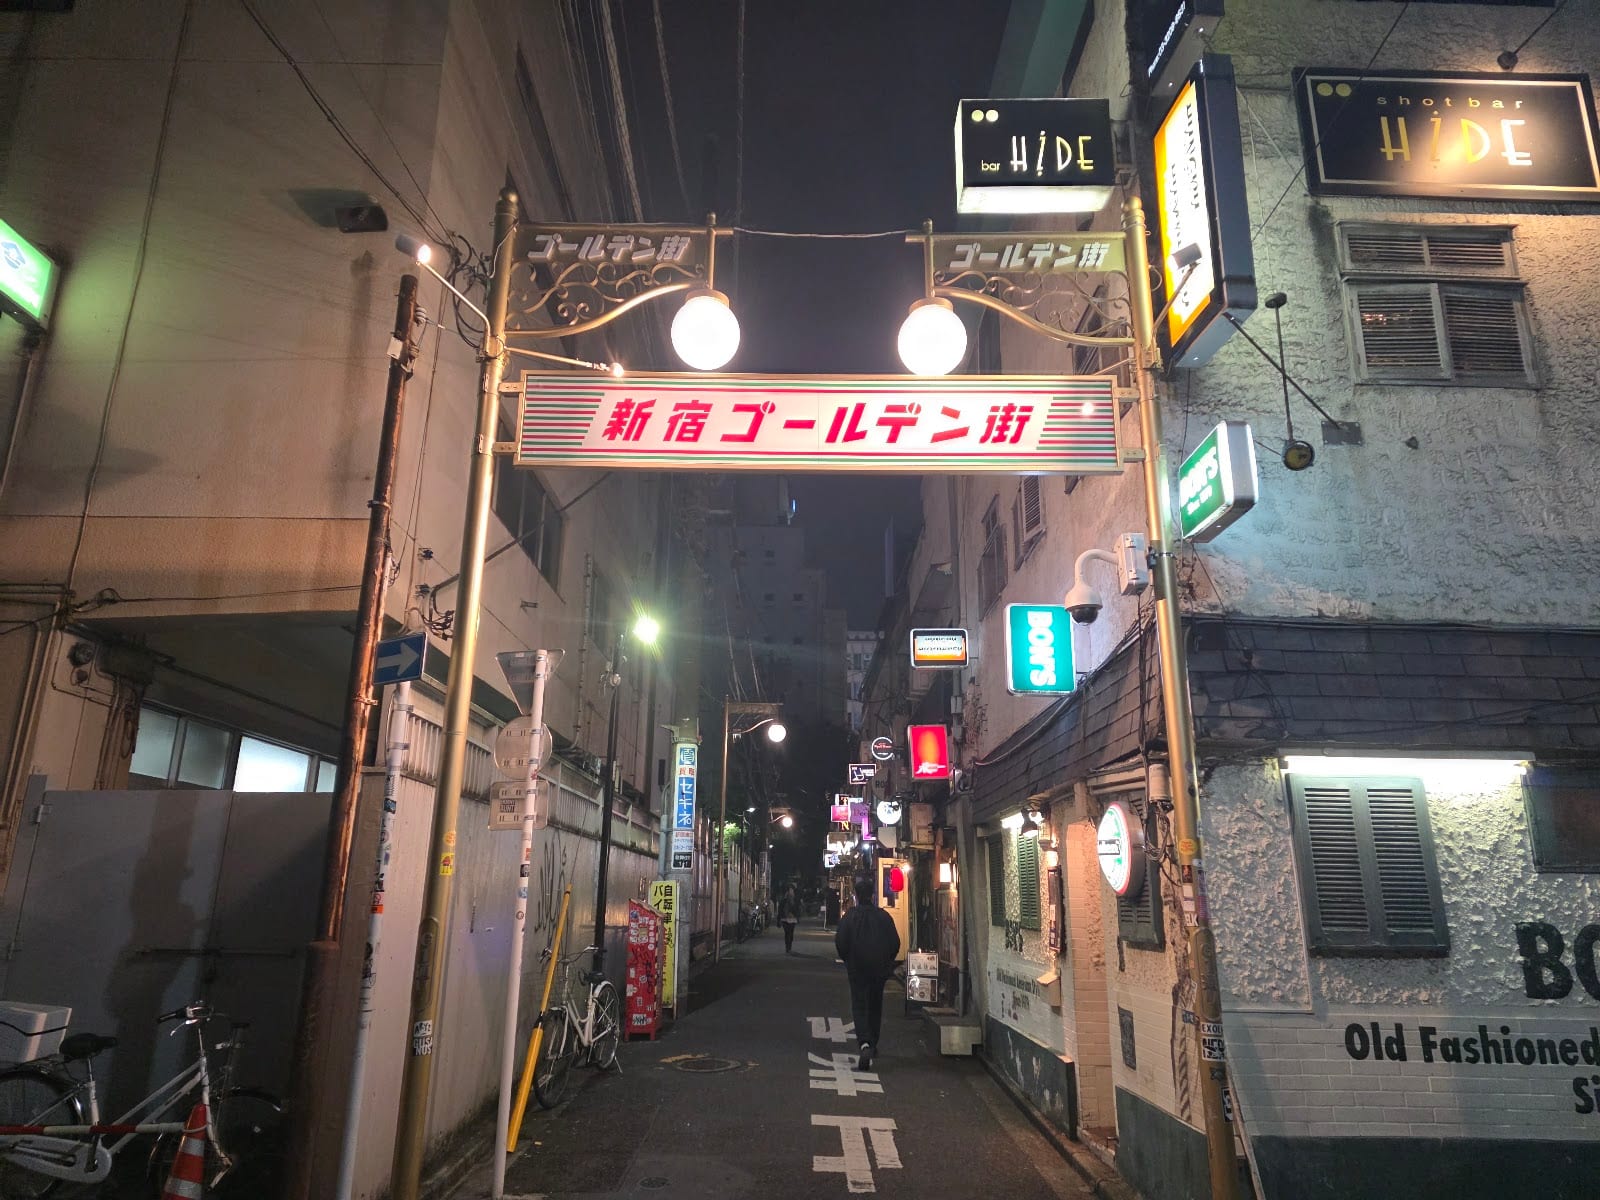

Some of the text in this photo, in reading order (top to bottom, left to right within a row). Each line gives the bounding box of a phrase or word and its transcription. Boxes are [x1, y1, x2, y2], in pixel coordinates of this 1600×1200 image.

[1377, 95, 1523, 109] shot bar
[981, 160, 1000, 171] bar
[528, 233, 691, 262] ゴールデン街
[950, 242, 1111, 269] ゴールデン街
[601, 398, 1031, 444] 新宿ゴールデン街
[678, 778, 694, 826] セキネ
[662, 884, 674, 925] 自転車
[1344, 1021, 1600, 1067] Old Fashioned
